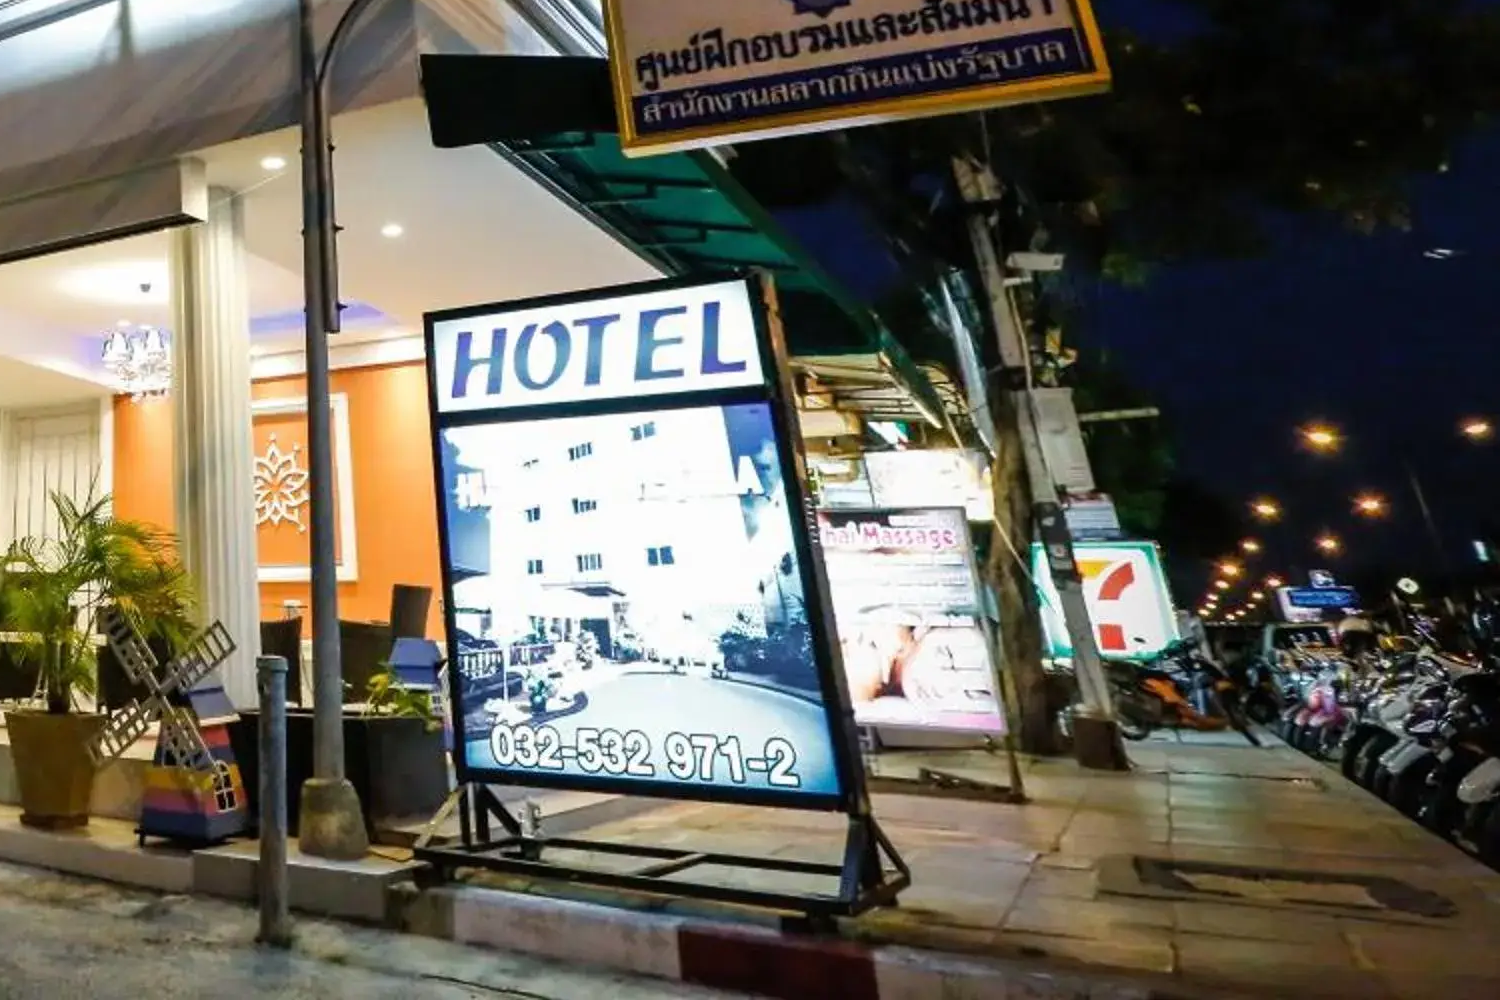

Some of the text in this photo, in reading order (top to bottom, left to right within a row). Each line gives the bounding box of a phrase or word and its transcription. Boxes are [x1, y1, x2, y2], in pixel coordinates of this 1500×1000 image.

[451, 301, 747, 398] HOTEL
[861, 526, 955, 549] Massage
[490, 724, 800, 787] 032-532 971-2
